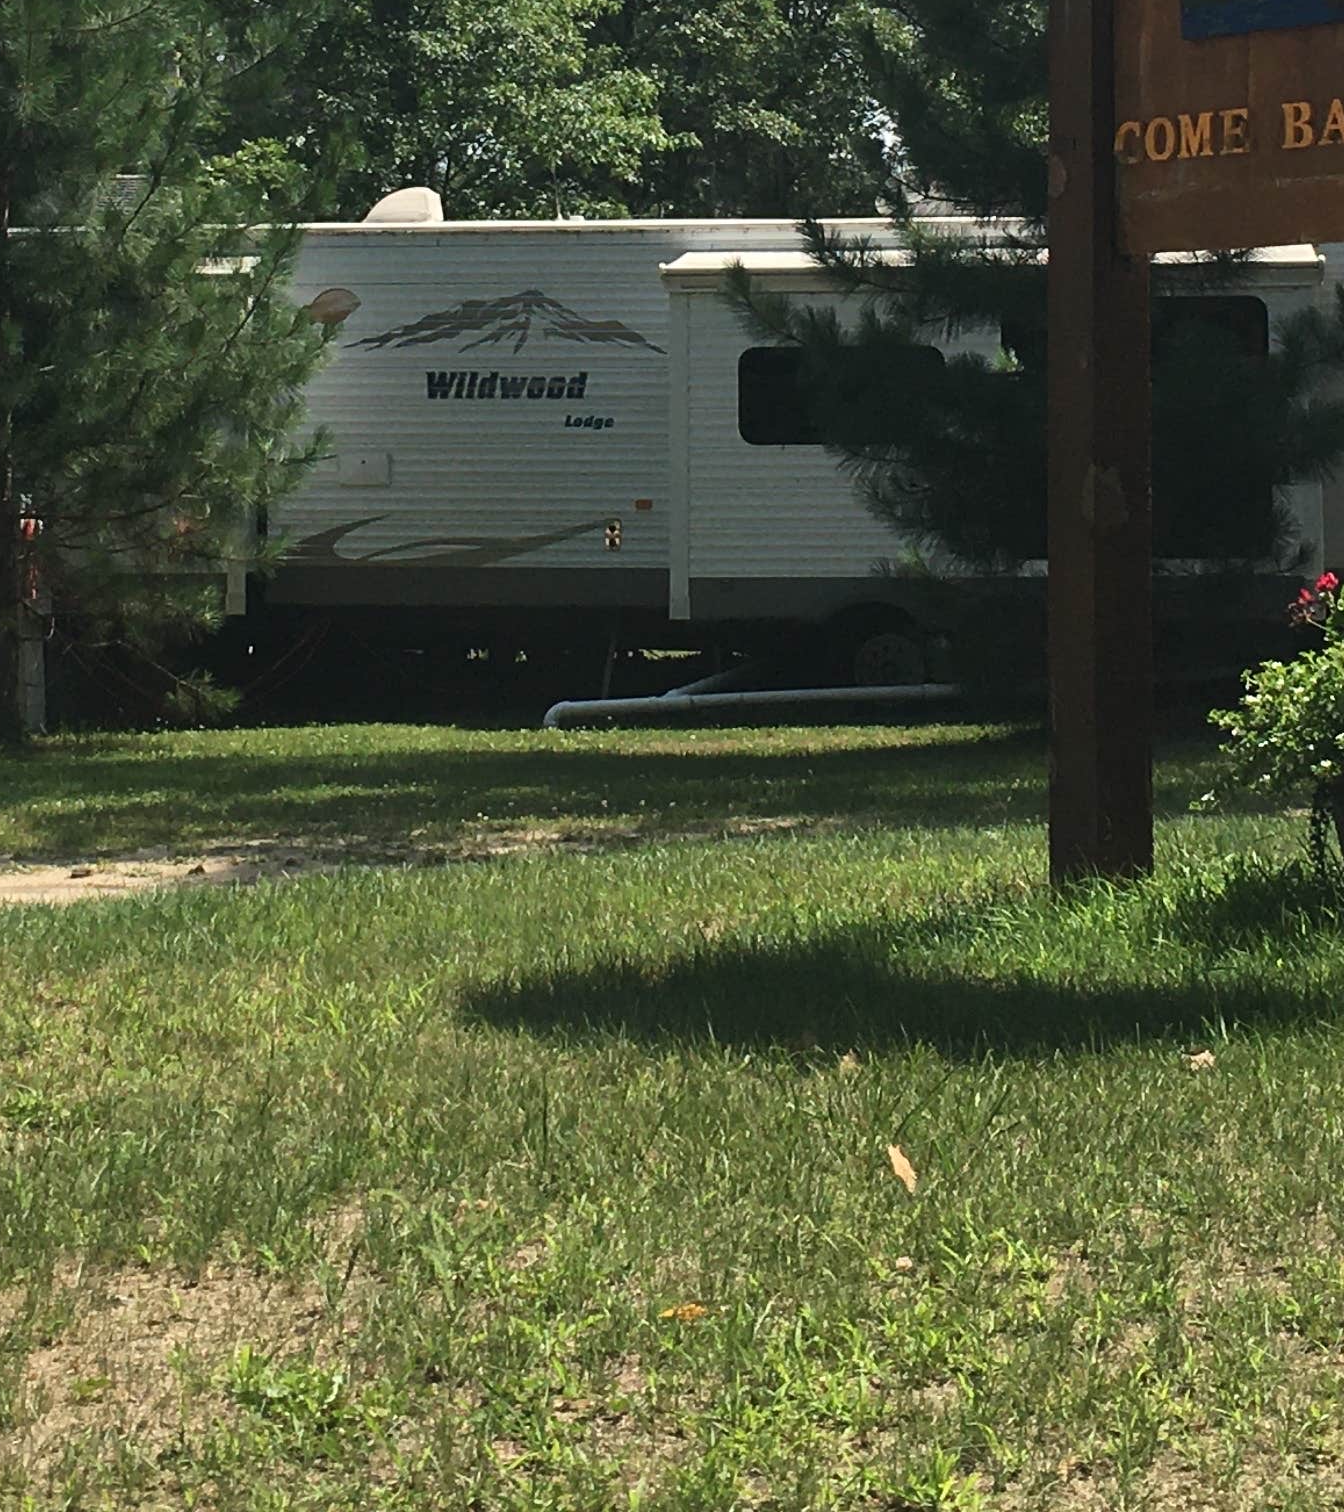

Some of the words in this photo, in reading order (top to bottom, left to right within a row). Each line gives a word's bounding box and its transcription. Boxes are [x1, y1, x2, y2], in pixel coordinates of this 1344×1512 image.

[1114, 108, 1251, 165] COME
[425, 370, 589, 401] Wildwood
[564, 414, 615, 430] Lodge
